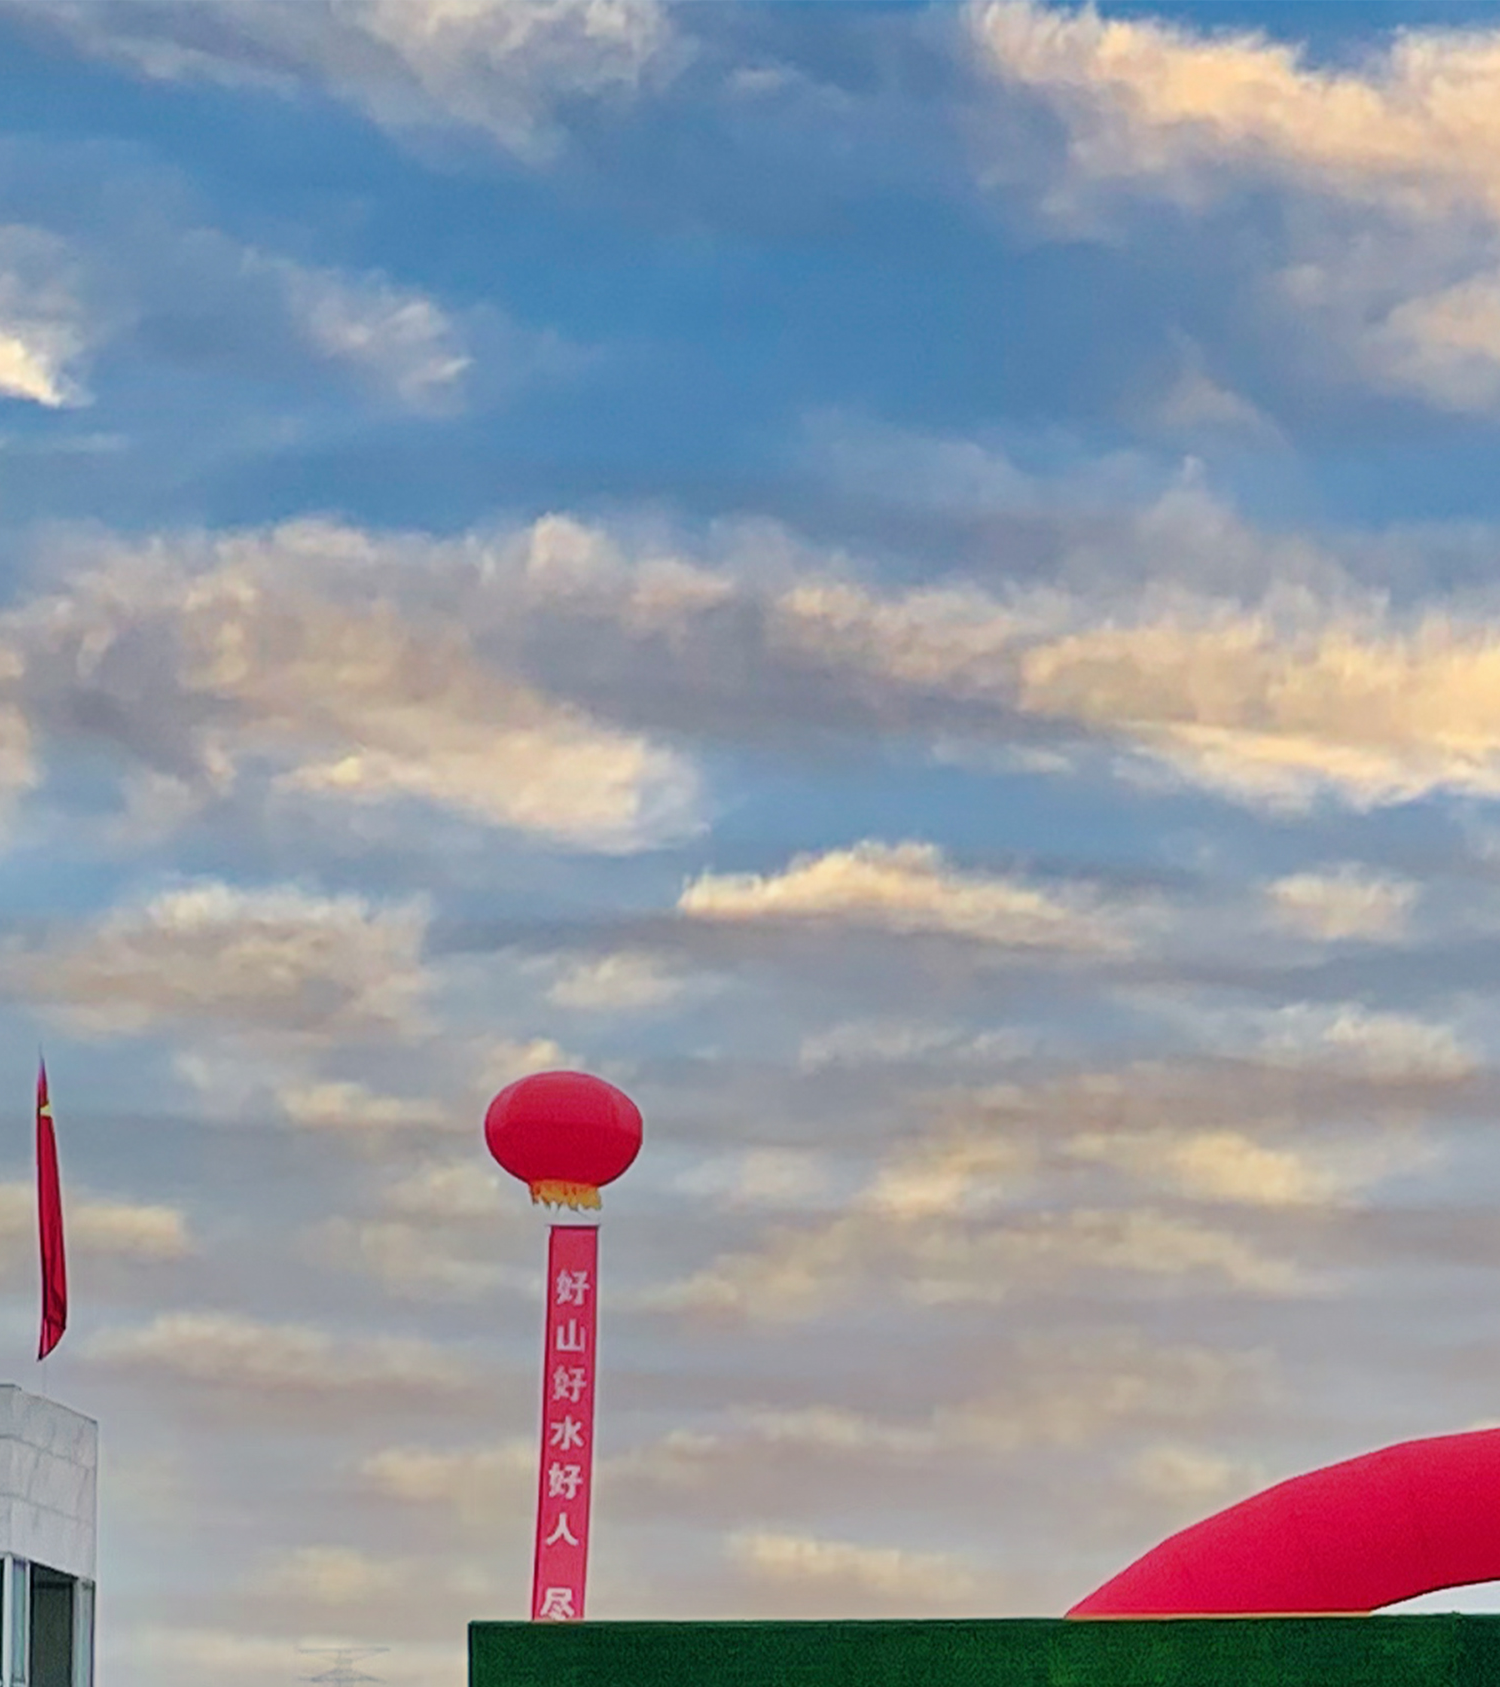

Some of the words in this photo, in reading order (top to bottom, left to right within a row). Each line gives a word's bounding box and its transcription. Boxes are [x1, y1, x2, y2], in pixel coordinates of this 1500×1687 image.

[545, 1269, 590, 1546] 好山好水好人
